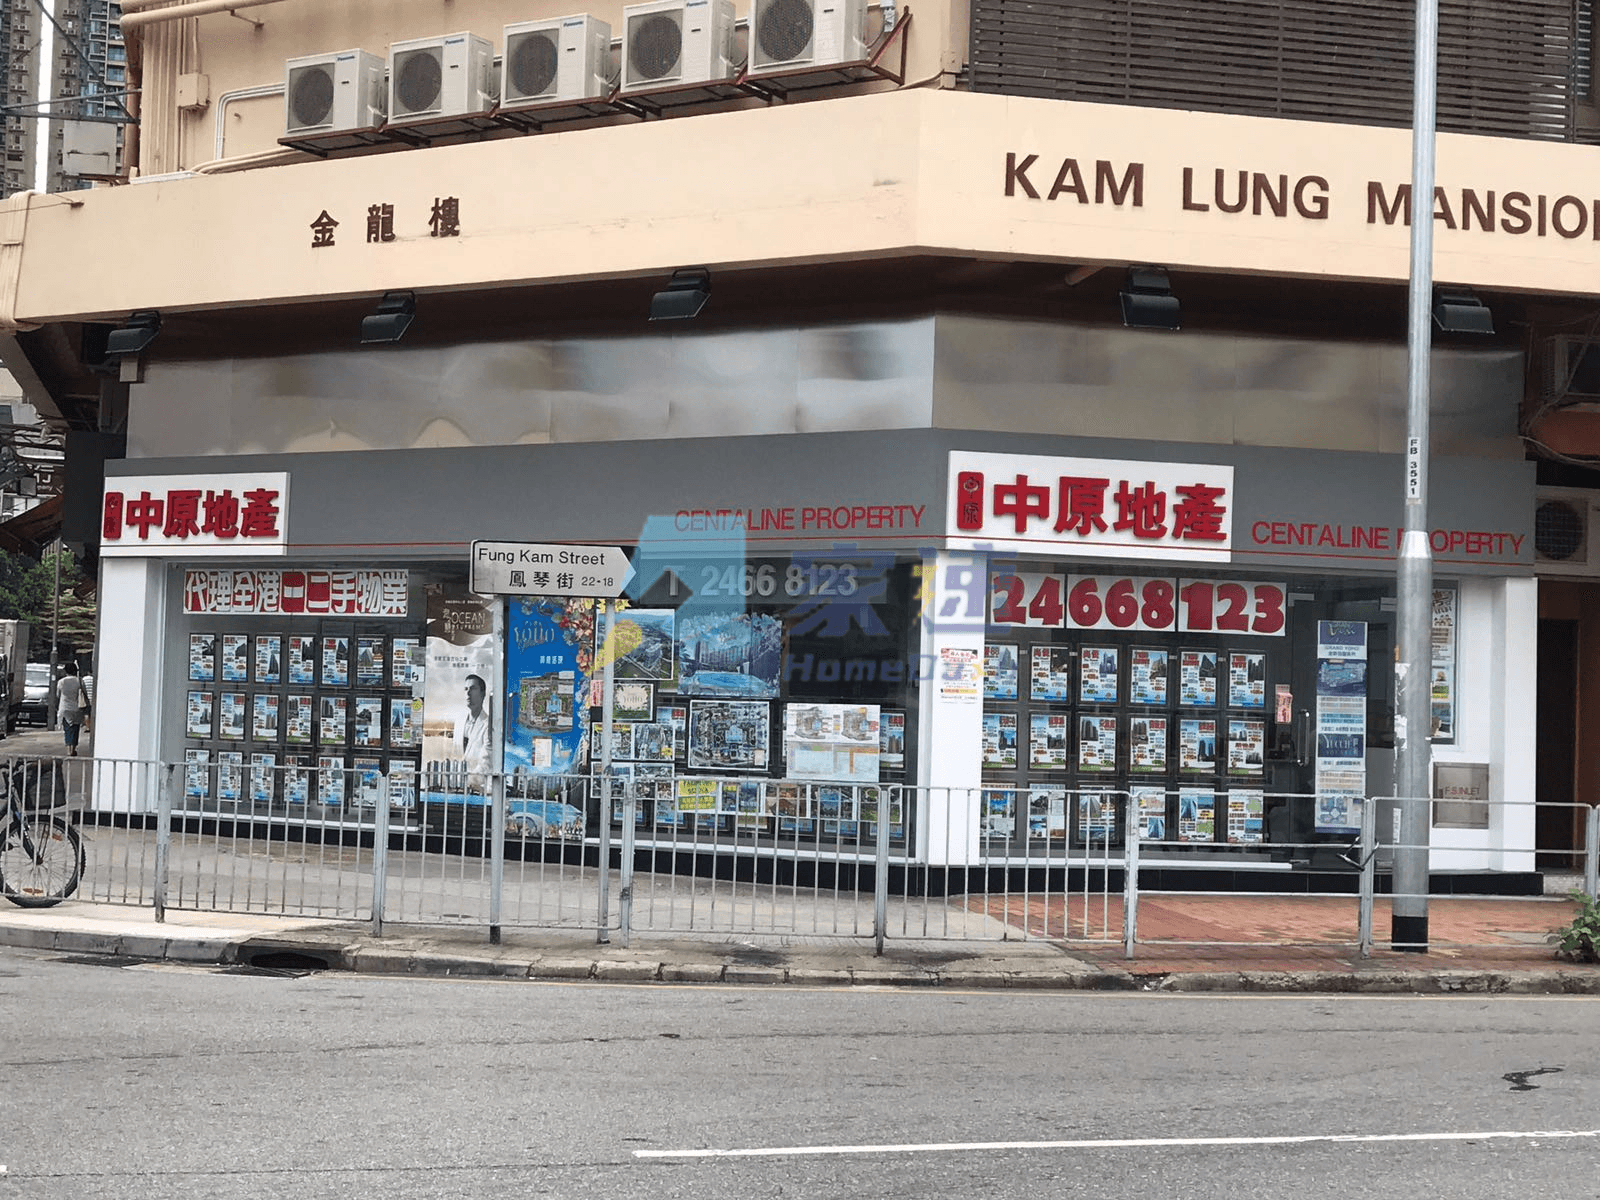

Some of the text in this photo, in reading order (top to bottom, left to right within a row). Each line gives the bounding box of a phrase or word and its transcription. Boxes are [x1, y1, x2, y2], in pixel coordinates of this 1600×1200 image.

[1004, 151, 1600, 241] KAM LUNG MANSIO
[310, 196, 460, 249] 金龍樓
[1410, 438, 1418, 455] FB
[126, 488, 280, 540] 中原地產
[674, 504, 926, 533] CENTALINE PROPERTY
[993, 474, 1228, 541] 中原地產
[1251, 520, 1525, 555] CENTALINE OPERTY
[478, 547, 605, 566] Fung Kam Street
[185, 570, 408, 615] 代理全港一二手物業
[509, 570, 574, 590] 鳳琴街
[700, 563, 776, 597] 2466
[784, 563, 859, 597] 8123
